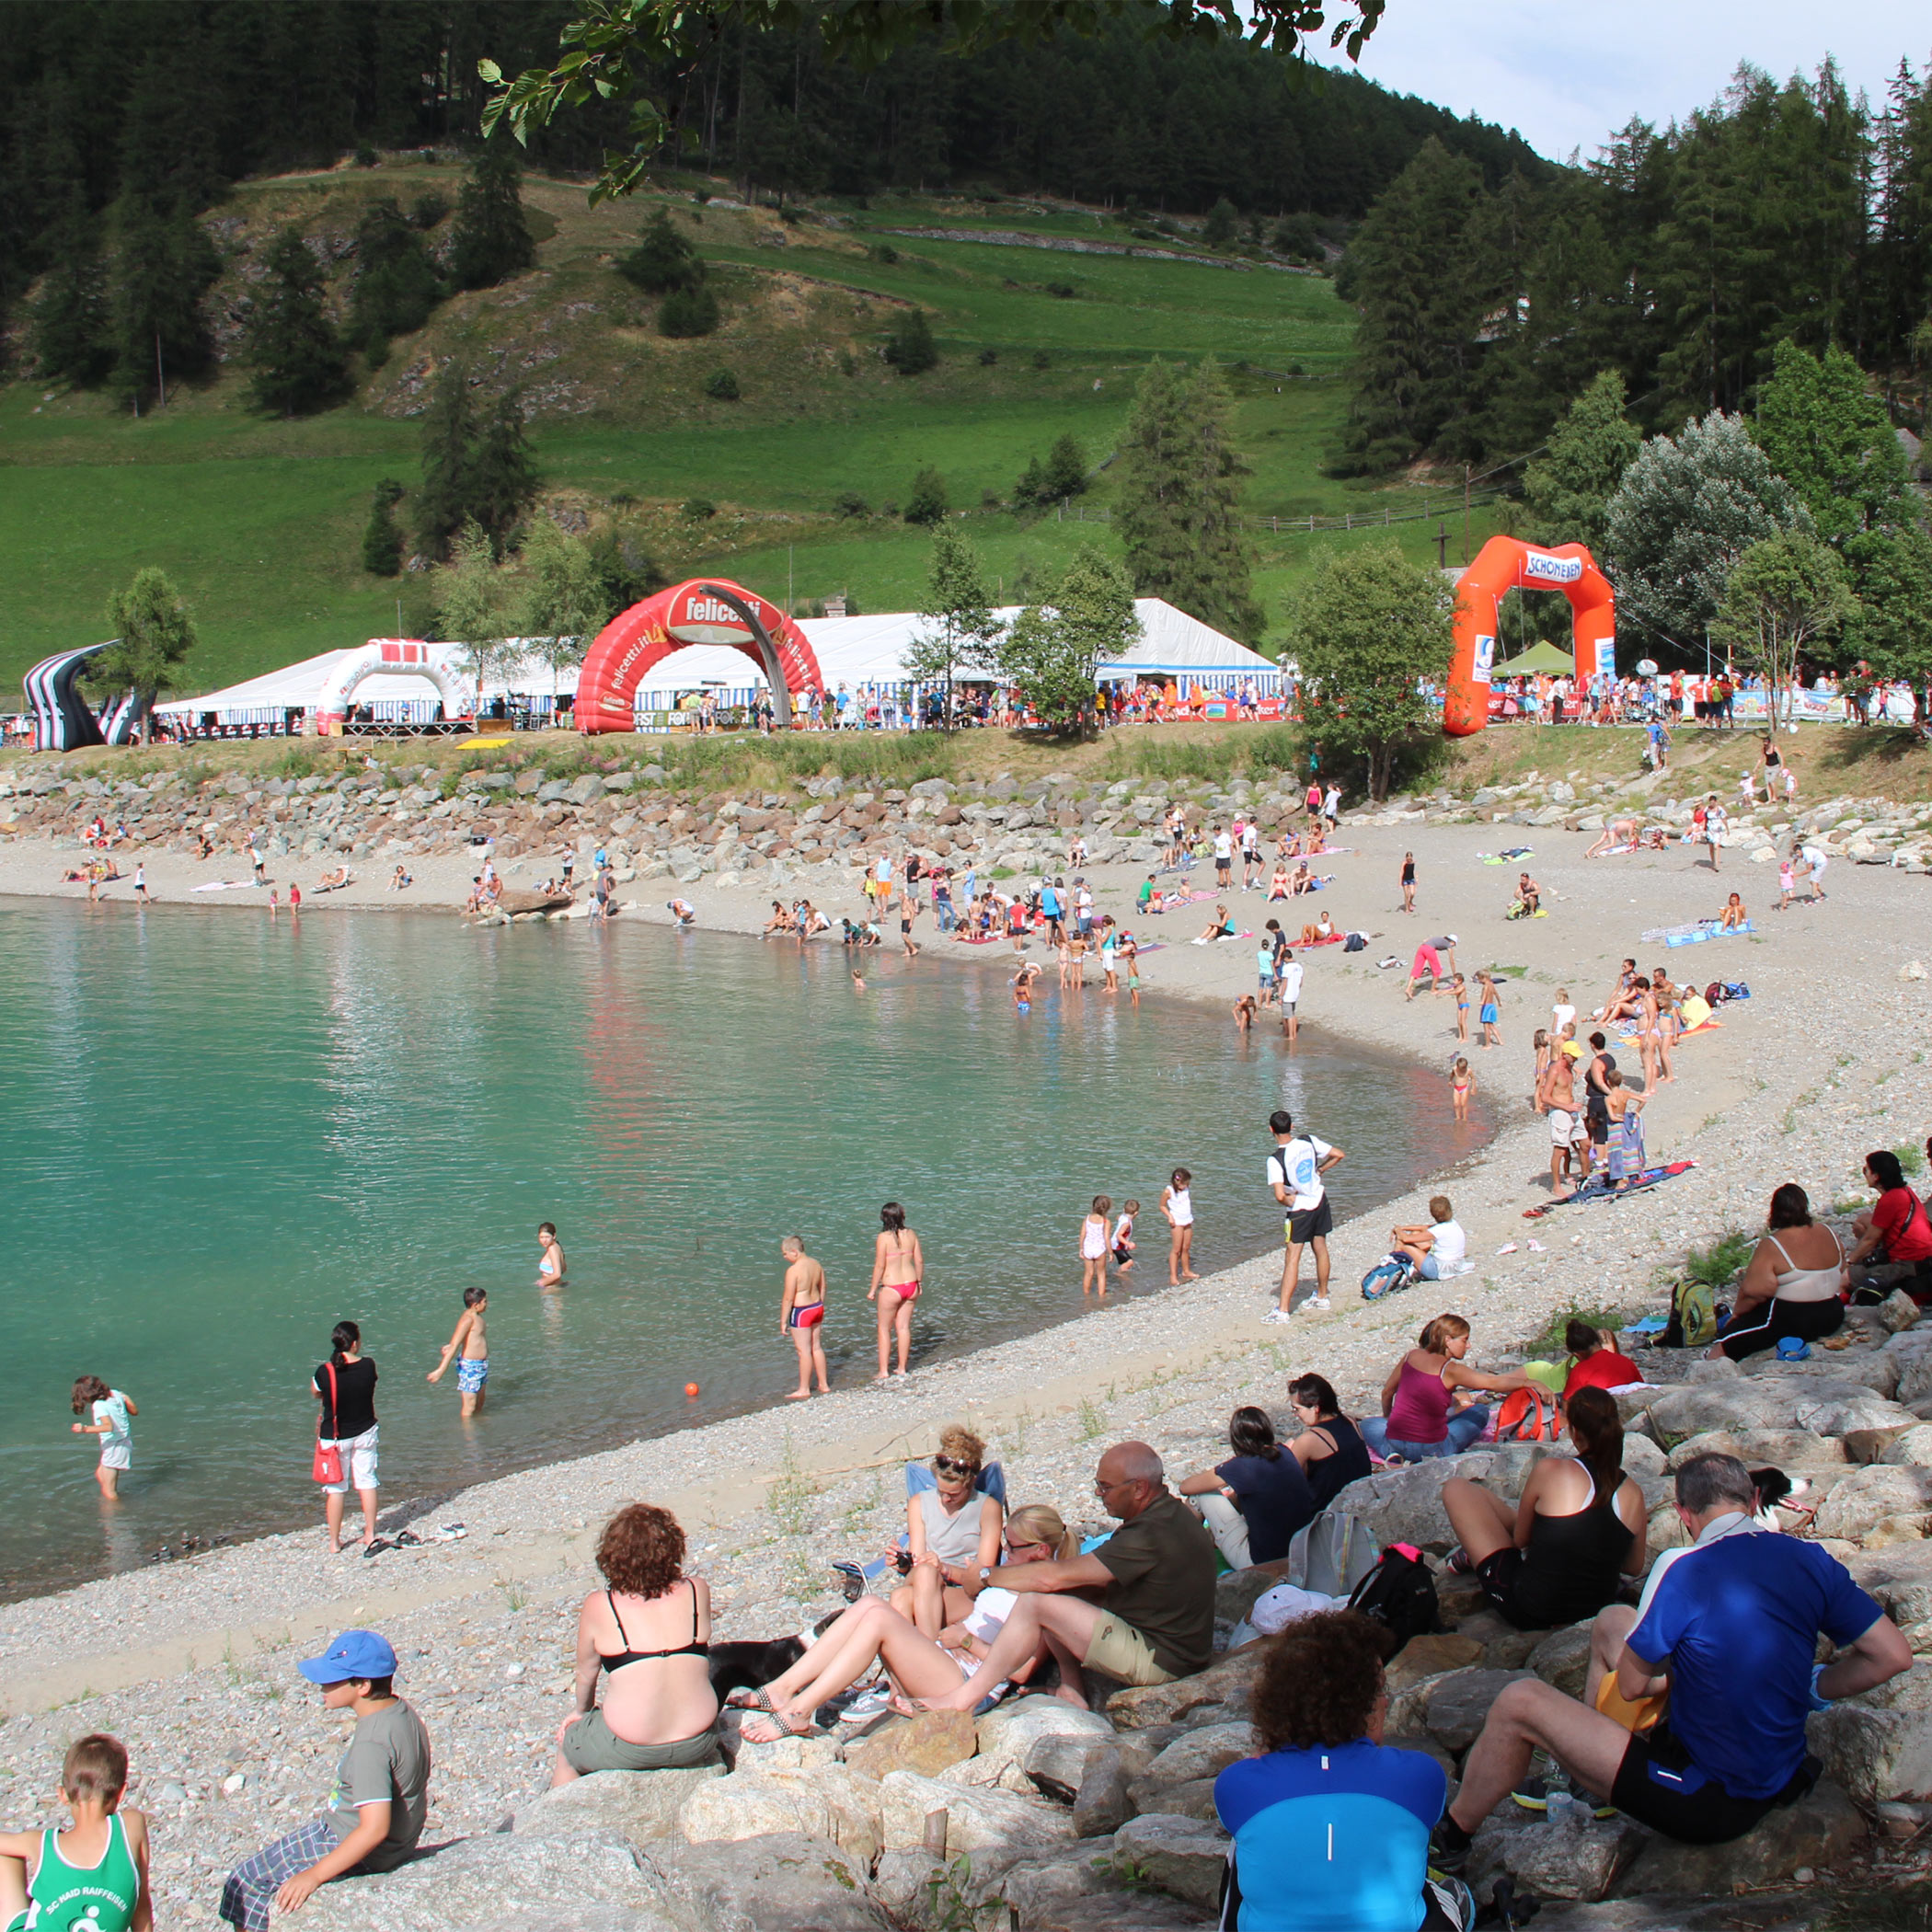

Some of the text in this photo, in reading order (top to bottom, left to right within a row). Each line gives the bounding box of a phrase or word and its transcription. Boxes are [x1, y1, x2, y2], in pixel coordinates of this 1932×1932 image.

[686, 597, 760, 622] felicei
[632, 713, 656, 726] RST
[45, 1900, 60, 1915] SC
[82, 1886, 128, 1913] RAIFFEISEN
